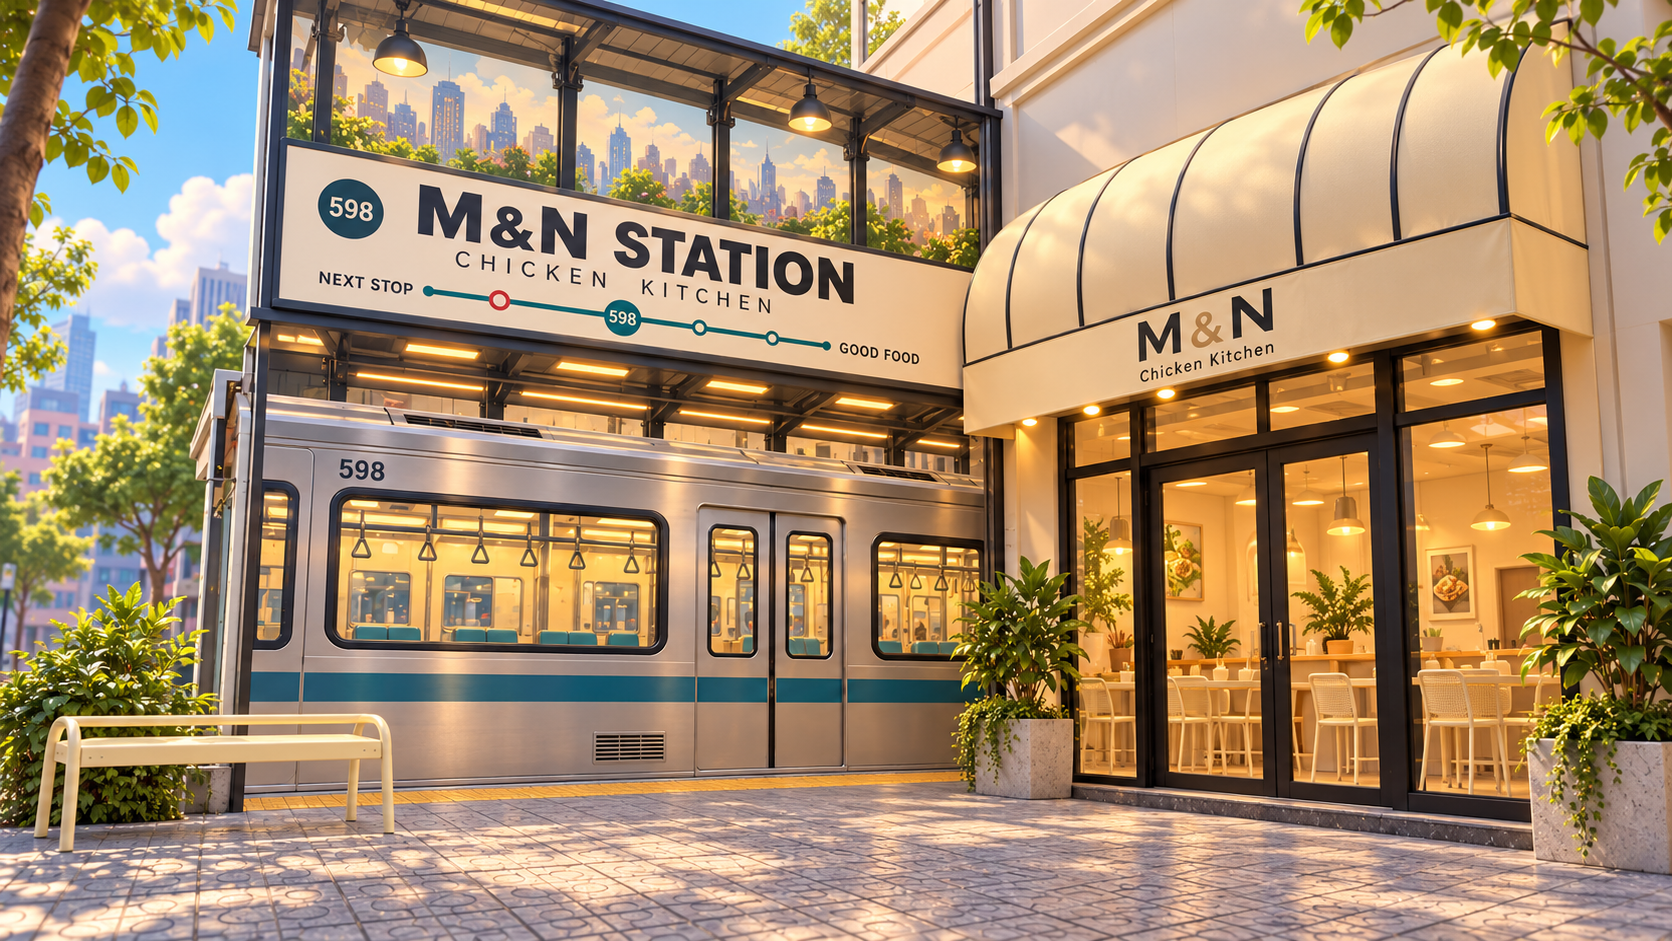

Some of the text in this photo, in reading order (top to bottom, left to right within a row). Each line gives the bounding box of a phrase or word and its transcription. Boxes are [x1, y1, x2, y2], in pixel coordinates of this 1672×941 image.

[328, 195, 375, 223] 598
[417, 183, 855, 305] M&N STATION
[318, 270, 414, 296] NEXT STOP
[455, 250, 772, 315] CHICKEN KITCHEN
[608, 309, 638, 327] 598
[839, 341, 920, 366] GOOD FOOD
[1139, 343, 1275, 383] Chicken Kitchen
[338, 458, 386, 482] 598
